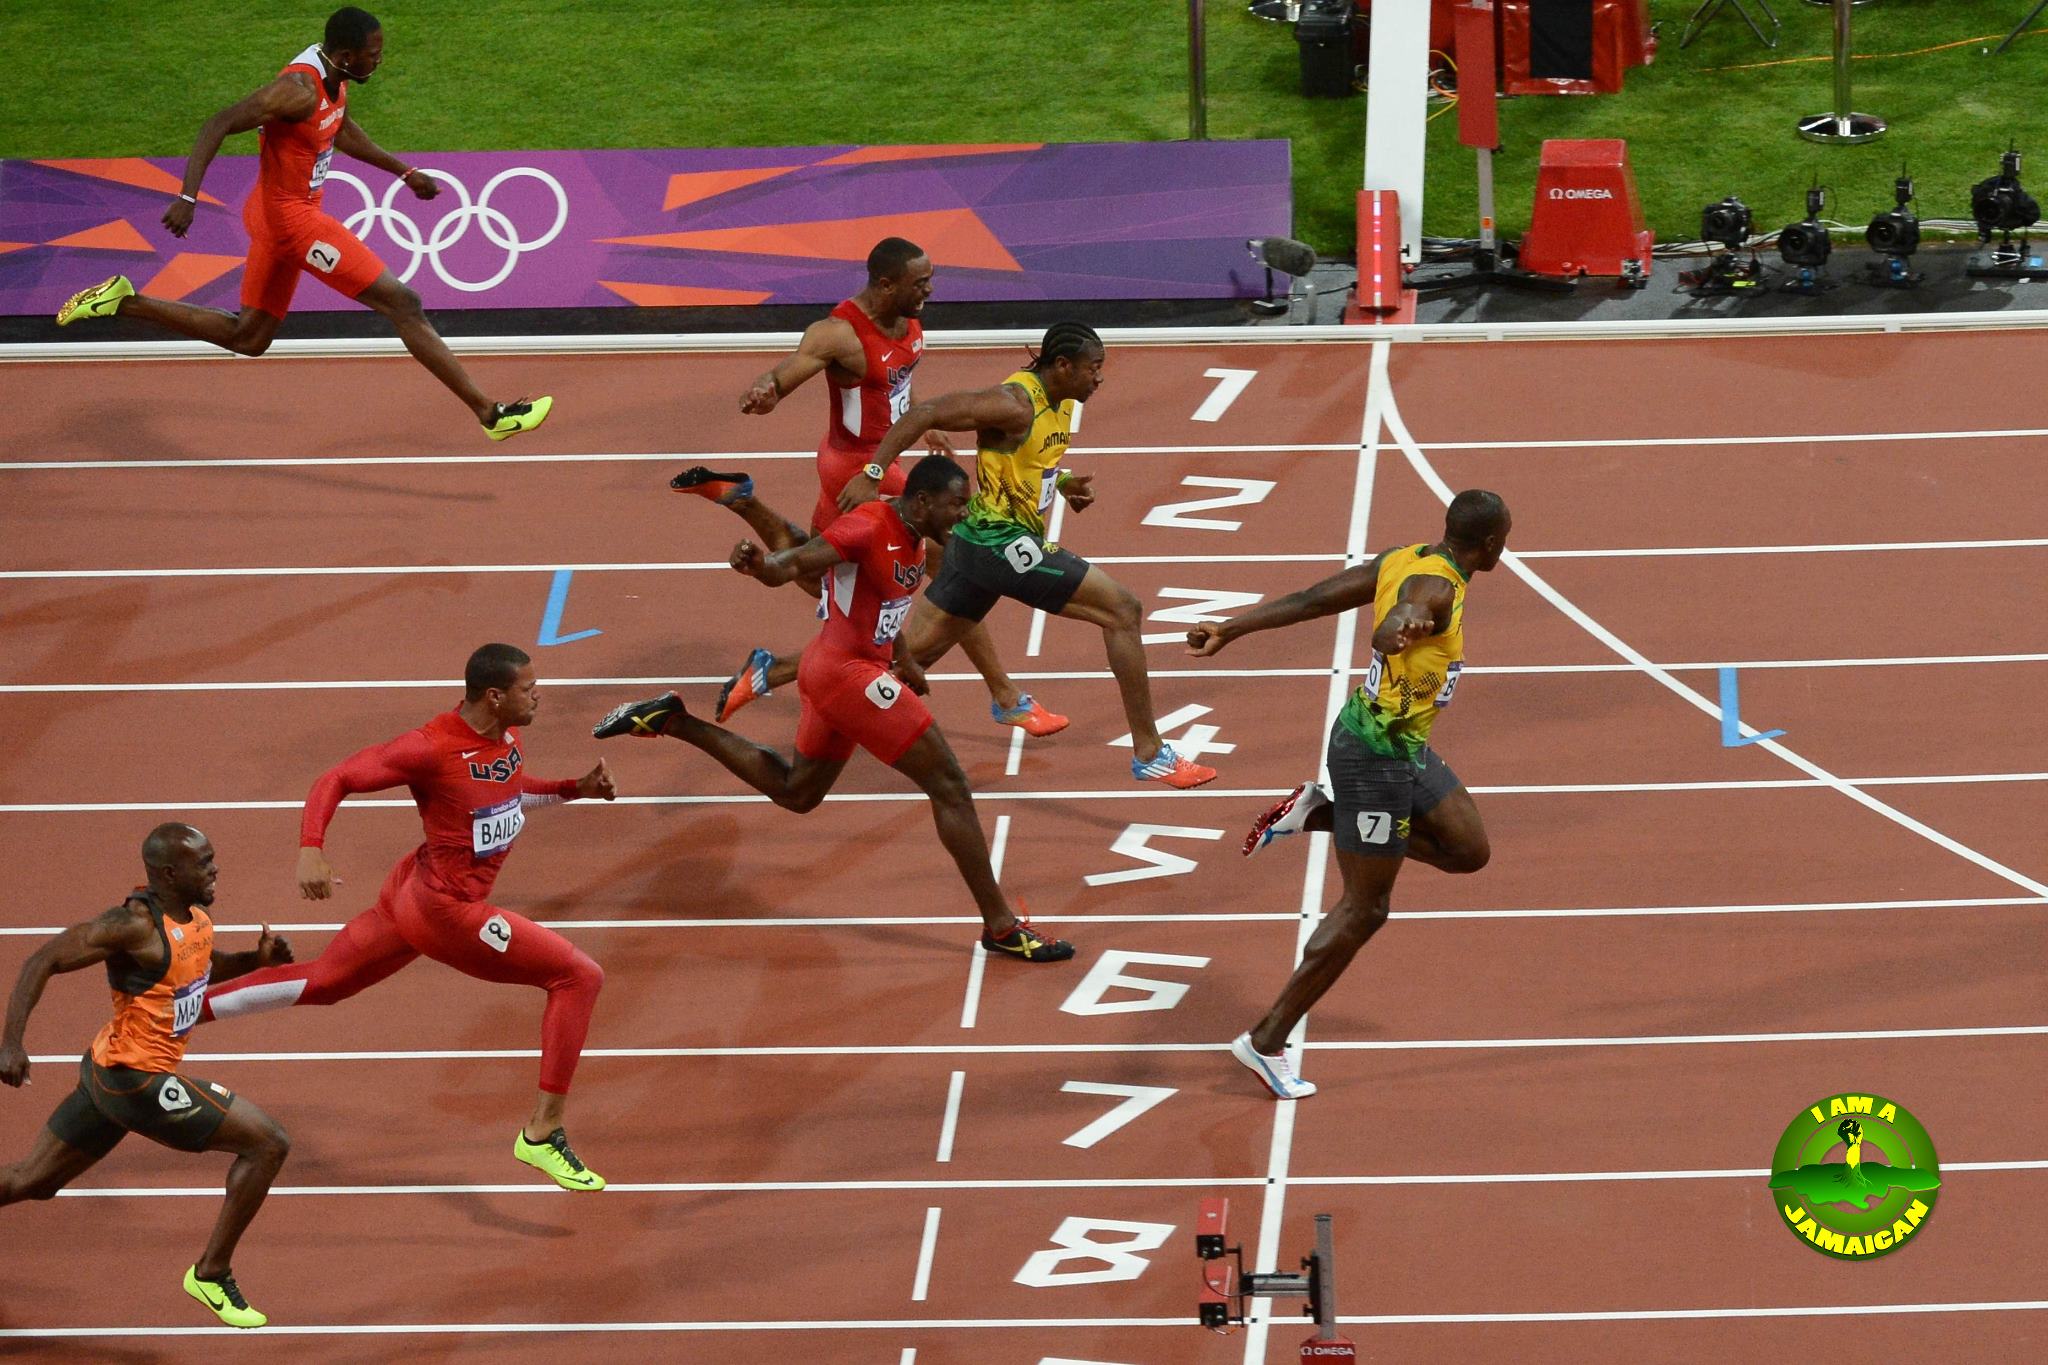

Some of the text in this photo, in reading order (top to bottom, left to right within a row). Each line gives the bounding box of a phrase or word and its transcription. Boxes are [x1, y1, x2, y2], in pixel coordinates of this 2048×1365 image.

[1565, 188, 1614, 200] OMEGA
[311, 248, 335, 268] 2
[1190, 367, 1258, 422] 1
[1140, 475, 1278, 532] 2
[1014, 542, 1033, 568] 5
[1141, 586, 1265, 645] 3
[876, 681, 895, 700] 6
[1106, 703, 1237, 764] 4
[469, 745, 522, 783] USA
[1366, 814, 1382, 839] 7
[1083, 823, 1226, 887] 5
[1058, 949, 1213, 1016] 6
[1059, 1080, 1180, 1149] 7
[1012, 1216, 1178, 1288] 8
[1314, 1346, 1355, 1356] OMEGA
